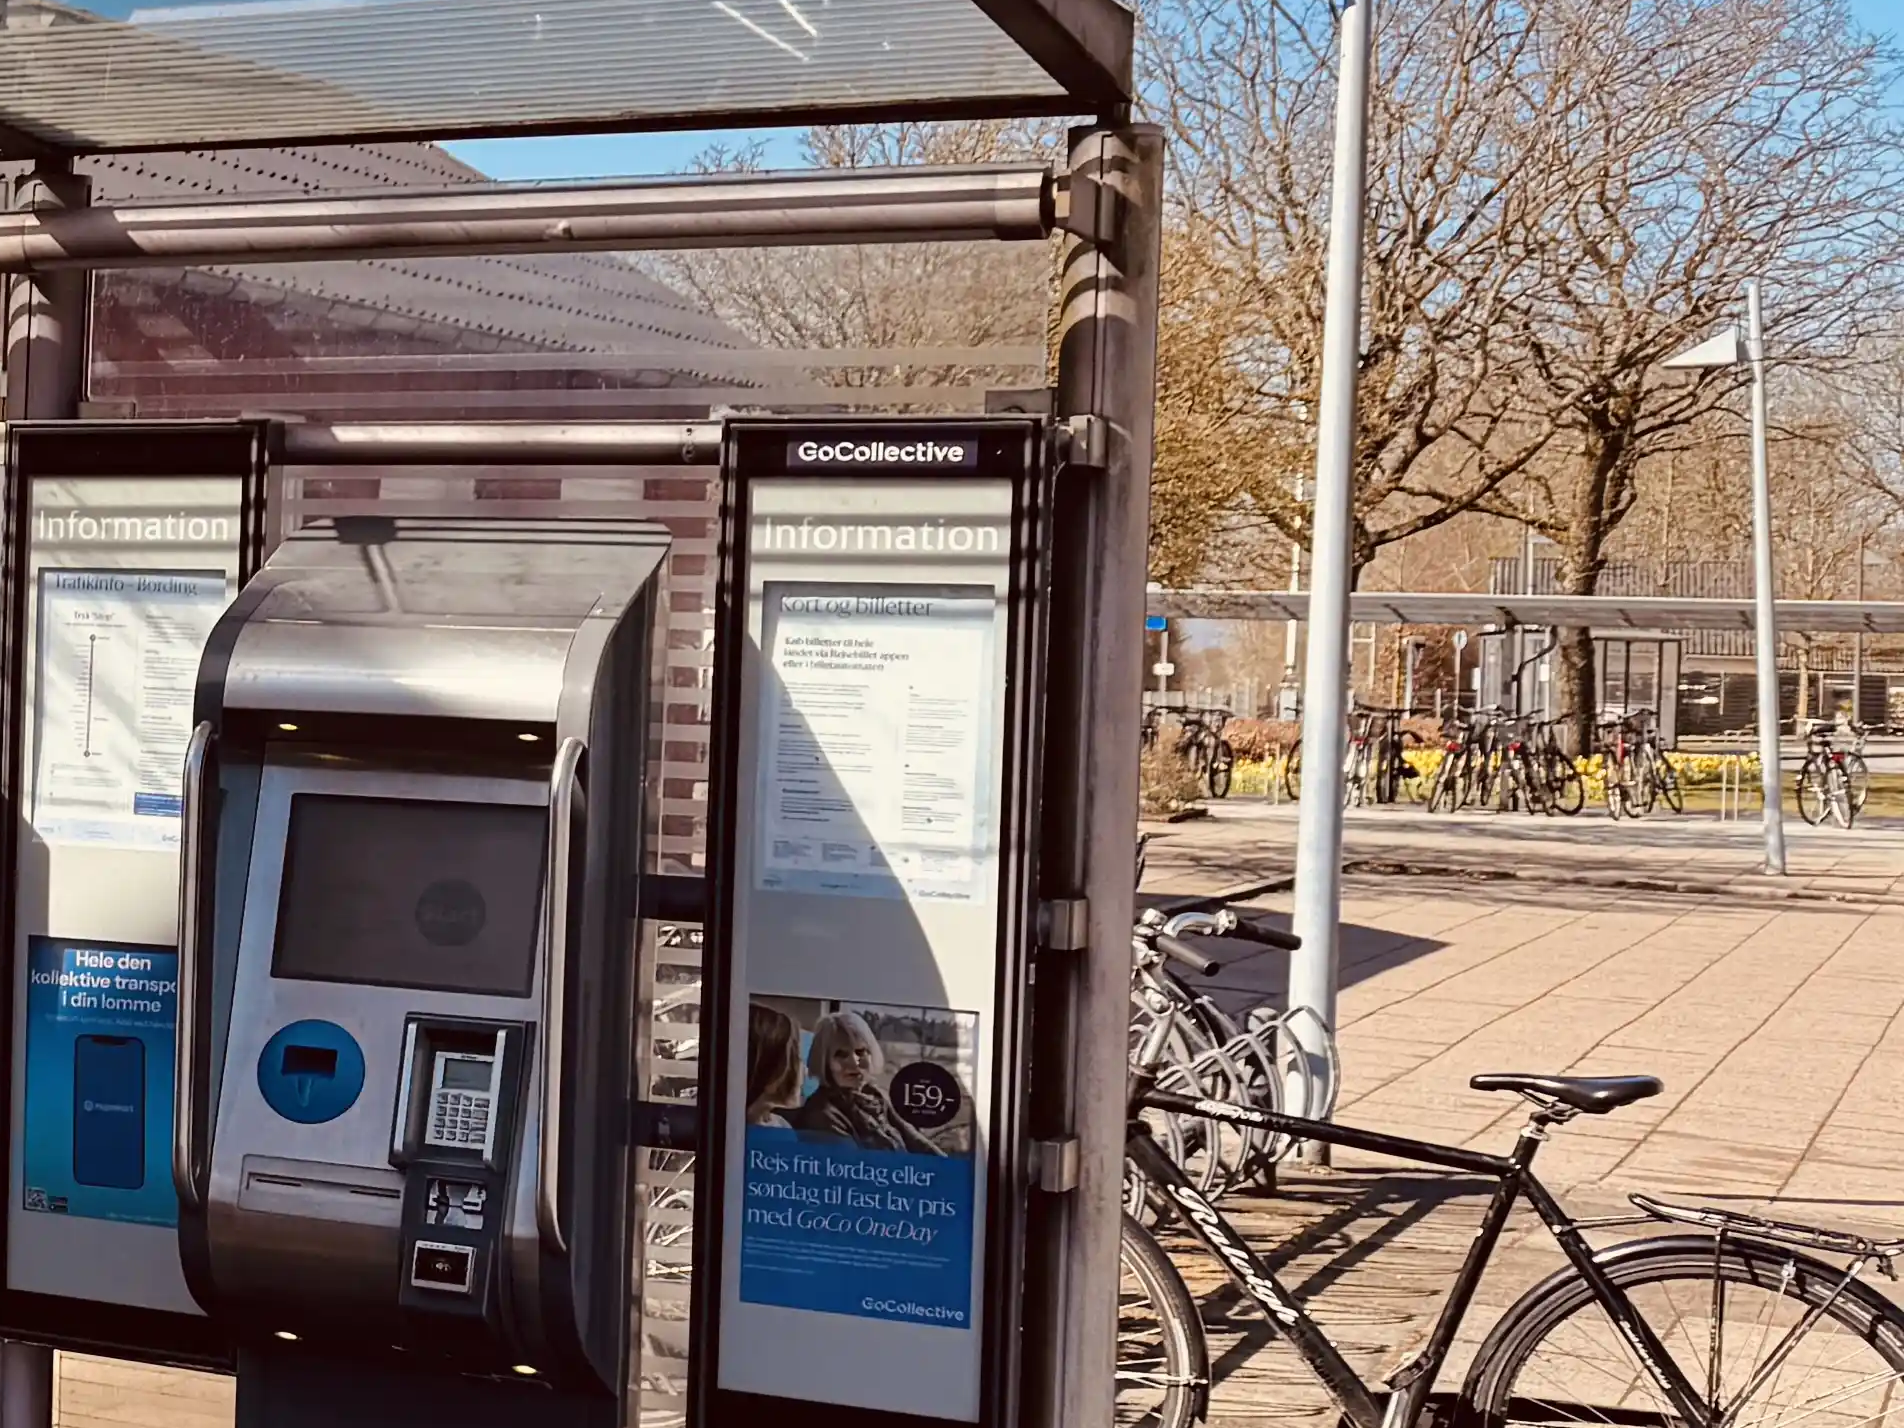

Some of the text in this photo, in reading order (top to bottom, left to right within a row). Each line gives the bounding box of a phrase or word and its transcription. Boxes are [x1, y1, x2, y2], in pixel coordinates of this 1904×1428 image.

[797, 441, 965, 463] GoCollective
[38, 510, 229, 541] Information
[764, 516, 999, 551] Information
[55, 574, 125, 592] Trafikinfo
[136, 576, 199, 596] Bording
[779, 596, 934, 617] Kort og billetter
[75, 949, 152, 972] Hele den
[31, 968, 111, 989] kollektive
[61, 990, 162, 1013] i din lomme
[903, 1082, 955, 1112] 159,-
[750, 1149, 936, 1187] Rejs frit lørdag eller
[747, 1180, 957, 1219] søndag til fast lav pris
[747, 1207, 939, 1246] med GoCo OneDay
[1167, 1183, 1300, 1327] Raleigh
[861, 1296, 965, 1322] GoCollective
